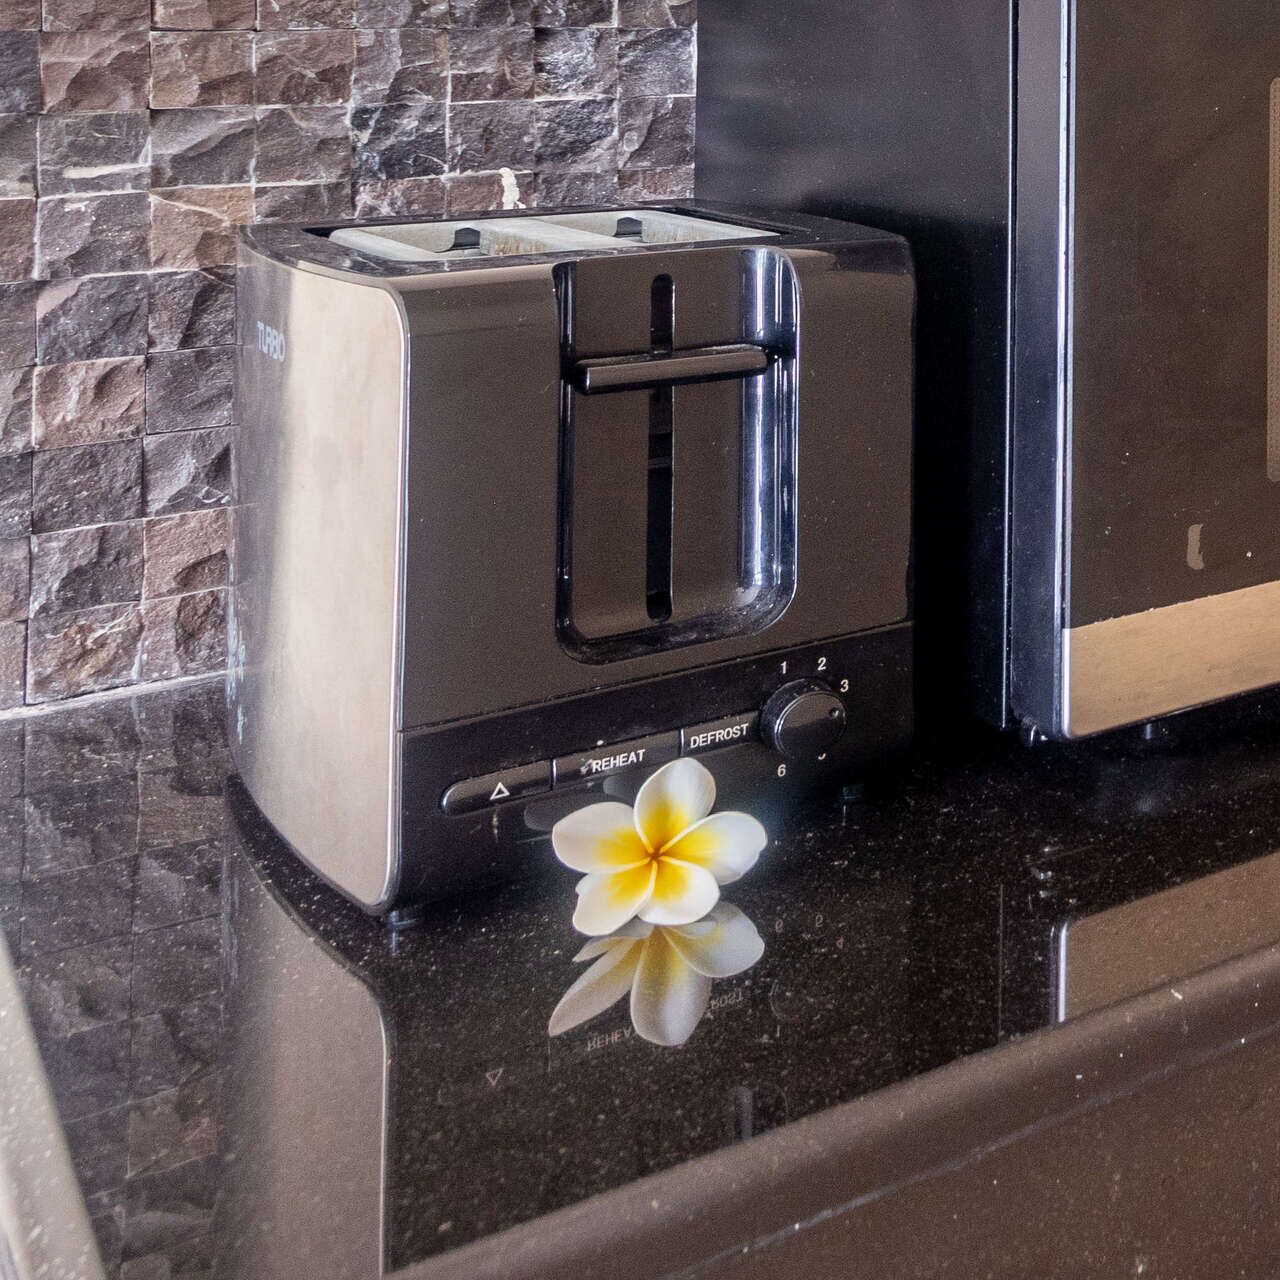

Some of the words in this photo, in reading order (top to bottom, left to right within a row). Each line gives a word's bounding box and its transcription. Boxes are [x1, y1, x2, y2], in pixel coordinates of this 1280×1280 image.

[256, 320, 286, 362] TURBO
[780, 660, 787, 674] 1
[817, 657, 827, 671] 2
[840, 679, 849, 693] 3
[690, 723, 749, 749] DEFROST
[592, 749, 646, 773] REHEAT
[777, 763, 787, 777] 6
